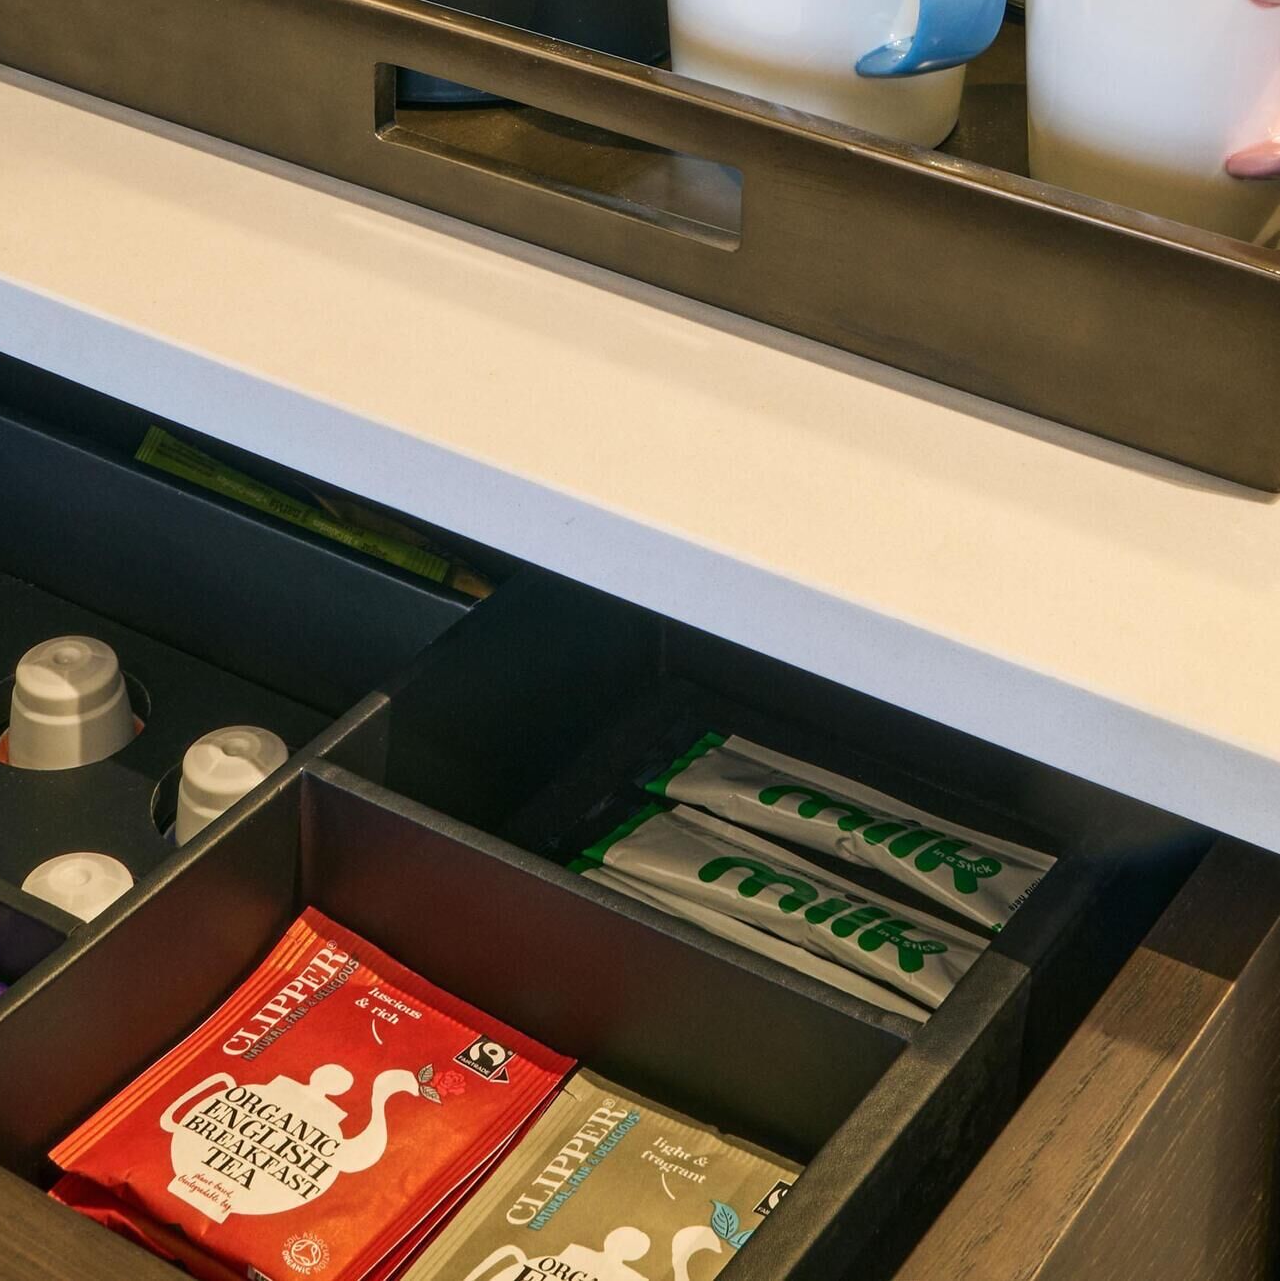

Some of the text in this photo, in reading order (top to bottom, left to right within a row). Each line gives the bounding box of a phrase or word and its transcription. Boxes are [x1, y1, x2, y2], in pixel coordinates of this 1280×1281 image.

[758, 784, 1003, 895] milk
[697, 855, 950, 974] milk
[285, 1005, 309, 1025] FAIR
[317, 957, 360, 1001] DELICIOUS
[354, 997, 400, 1025] & rich
[367, 986, 423, 1020] luscious
[457, 1054, 492, 1076] FAIRTRADE
[198, 1098, 333, 1183] ENGLISH
[224, 1085, 341, 1158] ORGANIC
[182, 1114, 321, 1200] BREAKFAST
[200, 1146, 257, 1191] TEA
[568, 1164, 593, 1189] FAIR
[594, 1111, 641, 1160] DELICIOUS
[640, 1149, 707, 1184] fragrant
[652, 1136, 710, 1168] light &
[281, 1249, 312, 1275] ORGANIC
[283, 1233, 301, 1250] SOIL
